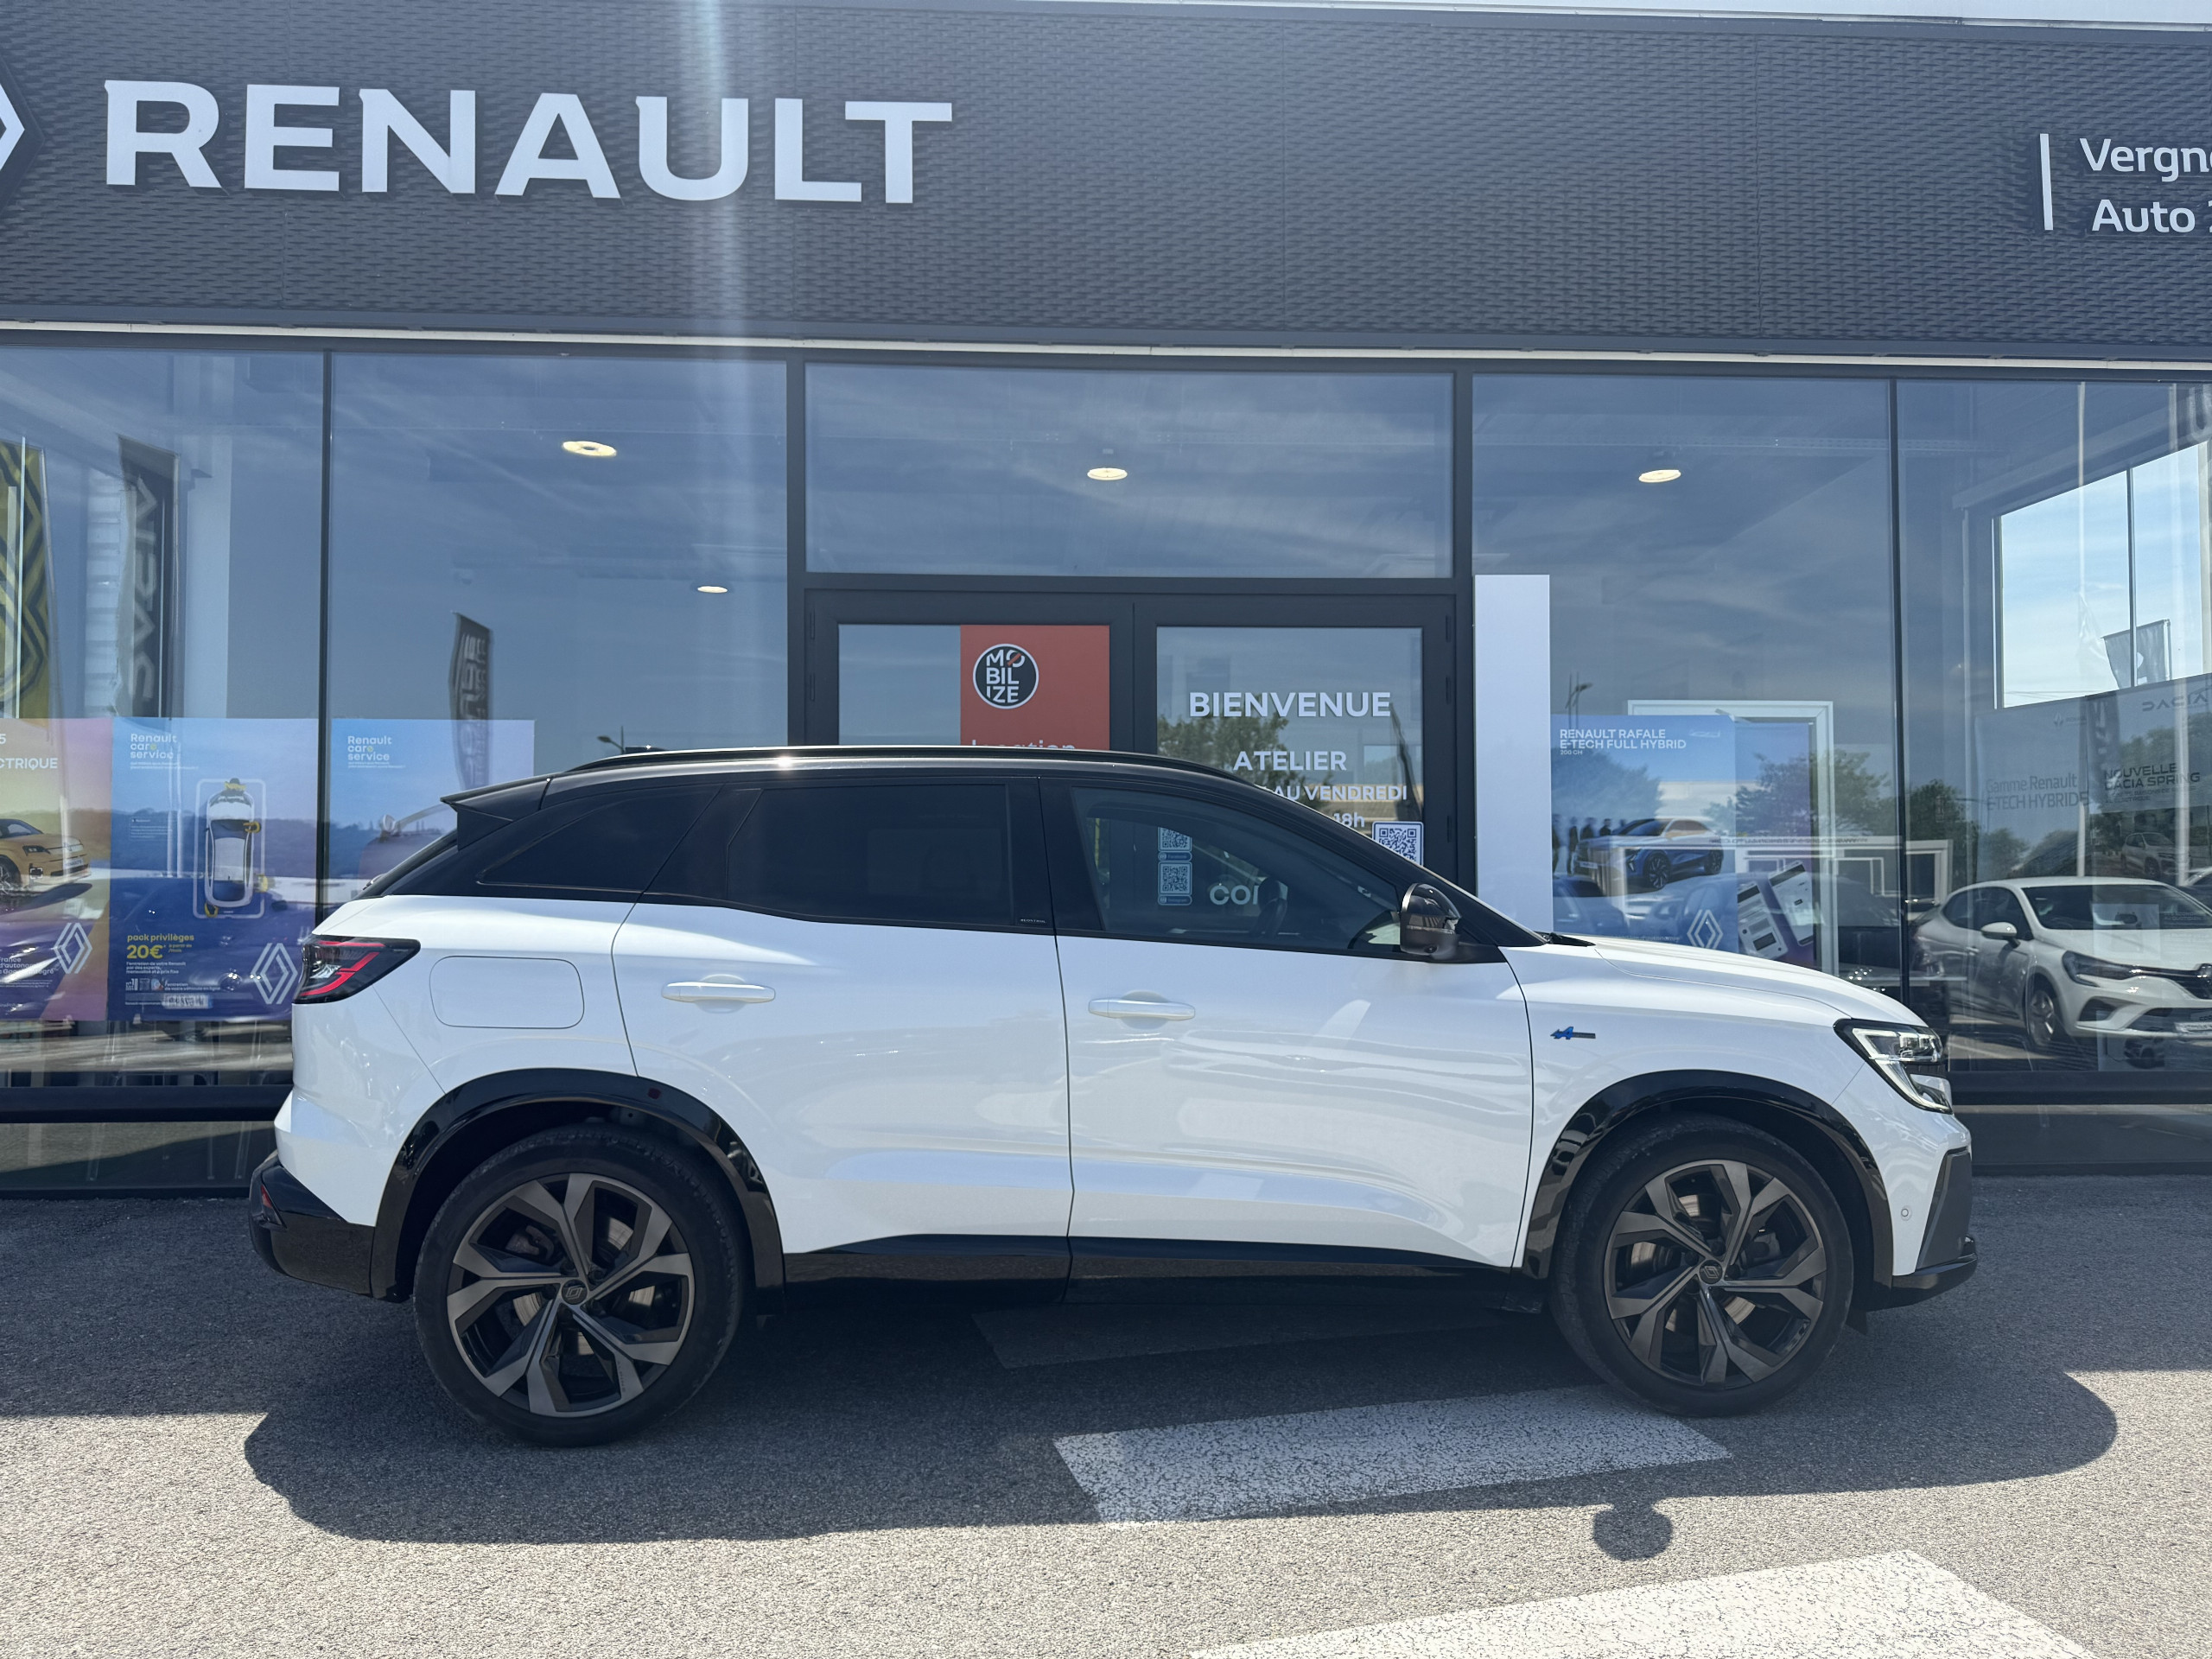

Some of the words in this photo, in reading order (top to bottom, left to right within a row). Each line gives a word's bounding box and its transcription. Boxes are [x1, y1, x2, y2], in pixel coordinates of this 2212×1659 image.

[105, 79, 952, 204] RENAULT
[2080, 138, 2212, 182] Vergn
[2092, 199, 2196, 232] Auto
[1190, 691, 1391, 717] BIENVENUE
[130, 734, 177, 743] Renault
[347, 735, 392, 745] Renault
[1560, 729, 1617, 739] RENAULT
[1618, 729, 1666, 739] RAFALE
[1560, 739, 1604, 749] E-TECH
[1606, 739, 1637, 749] FULL
[1641, 739, 1687, 749] HYBRID
[130, 749, 174, 759] service
[347, 752, 390, 760] service
[1233, 751, 1347, 771] ATELIER
[2104, 762, 2177, 779] NOUVELLE
[1986, 779, 2027, 793] Gamme
[2030, 772, 2078, 791] Renault
[1274, 785, 1300, 801] AU
[1304, 785, 1408, 801] VENDREDI
[2029, 791, 2089, 809] HYBRIDE
[127, 934, 149, 943] pack
[150, 933, 194, 943] privilèges
